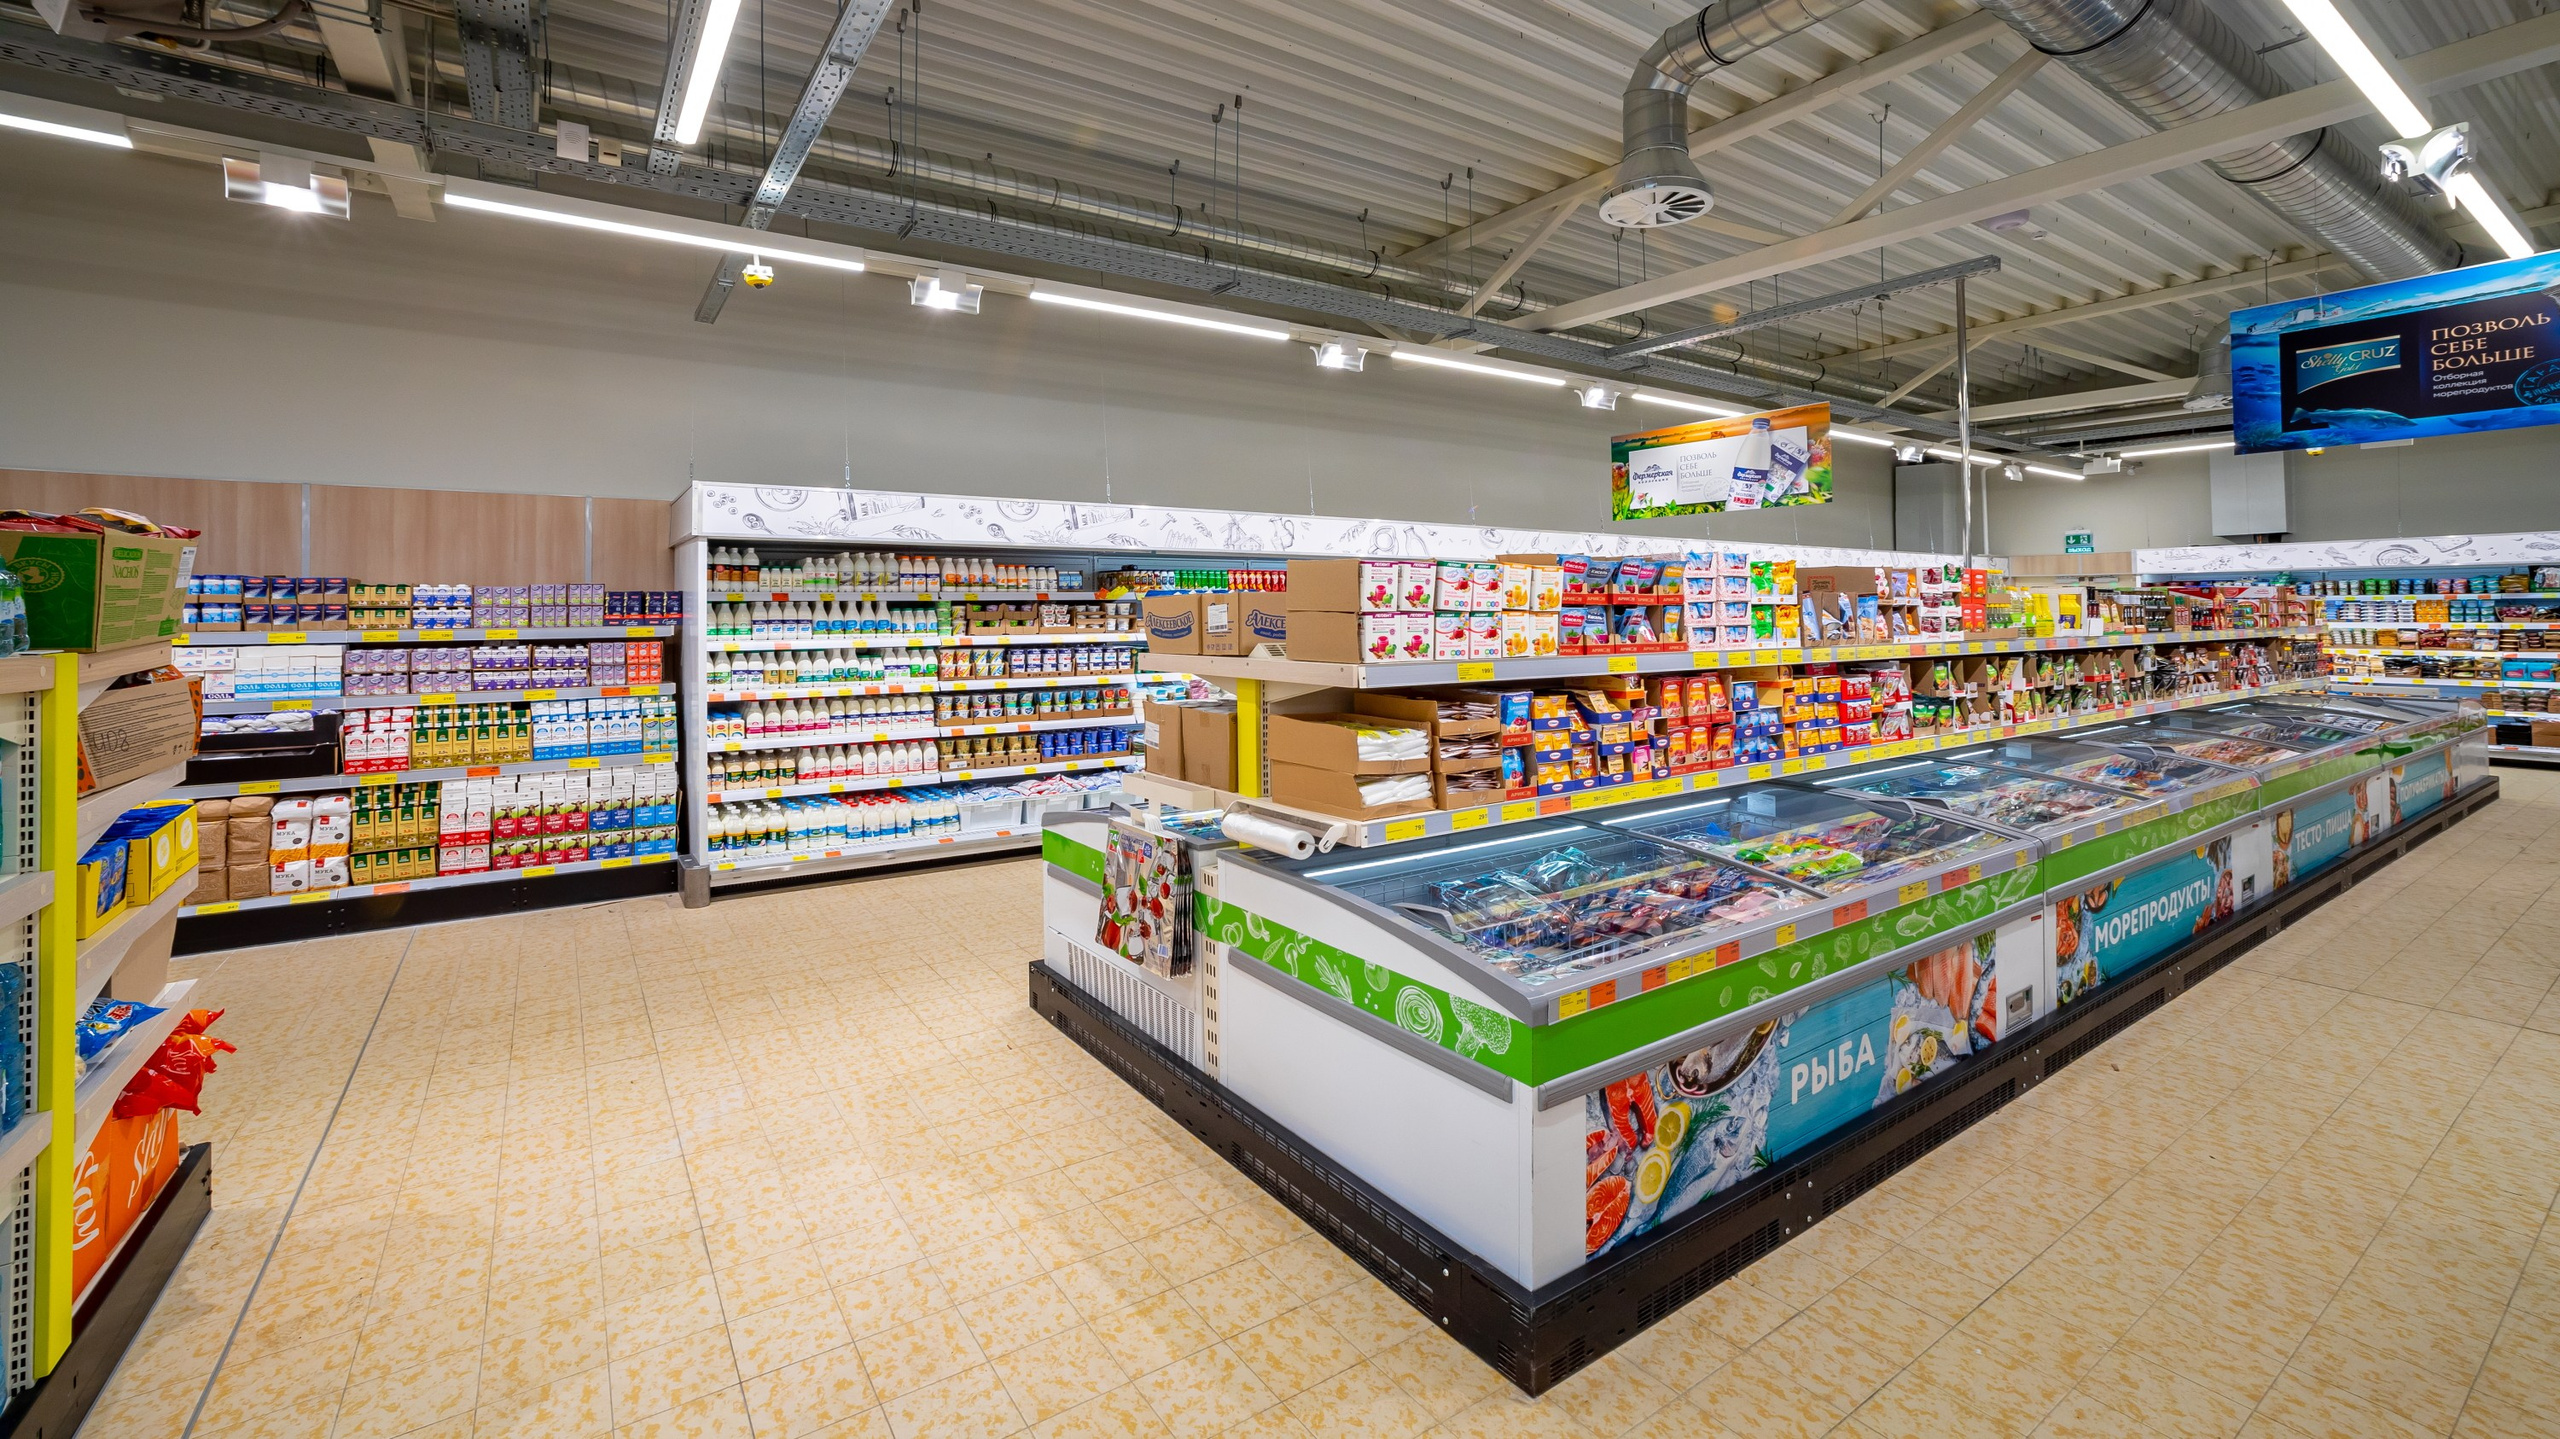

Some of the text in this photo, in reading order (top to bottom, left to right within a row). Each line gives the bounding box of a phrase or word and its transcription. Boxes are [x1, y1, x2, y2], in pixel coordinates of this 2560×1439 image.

[2431, 312, 2551, 341] ПОЗВОЛЬ
[2430, 337, 2488, 356] СЕБЕ
[2300, 344, 2397, 369] Shelly CRUZ
[2432, 346, 2535, 372] БОЛЬШЕ
[2334, 362, 2362, 374] Gold
[2432, 370, 2484, 382] Отборная
[2433, 379, 2487, 390] коллекция
[2433, 384, 2514, 398] морепродуктов
[1680, 452, 1717, 462] ПОЗВОЛЬ
[1680, 462, 1698, 470] СЕБЕ
[1680, 468, 1712, 480] БОЛЬШЕ
[1145, 611, 1194, 630] АЛЕКСЕЕВСКОЕ
[2294, 824, 2322, 852] ТЕСТО
[2094, 876, 2212, 953] МОРЕПРОДУКТЫ
[1791, 1033, 1876, 1104] РЫБА
